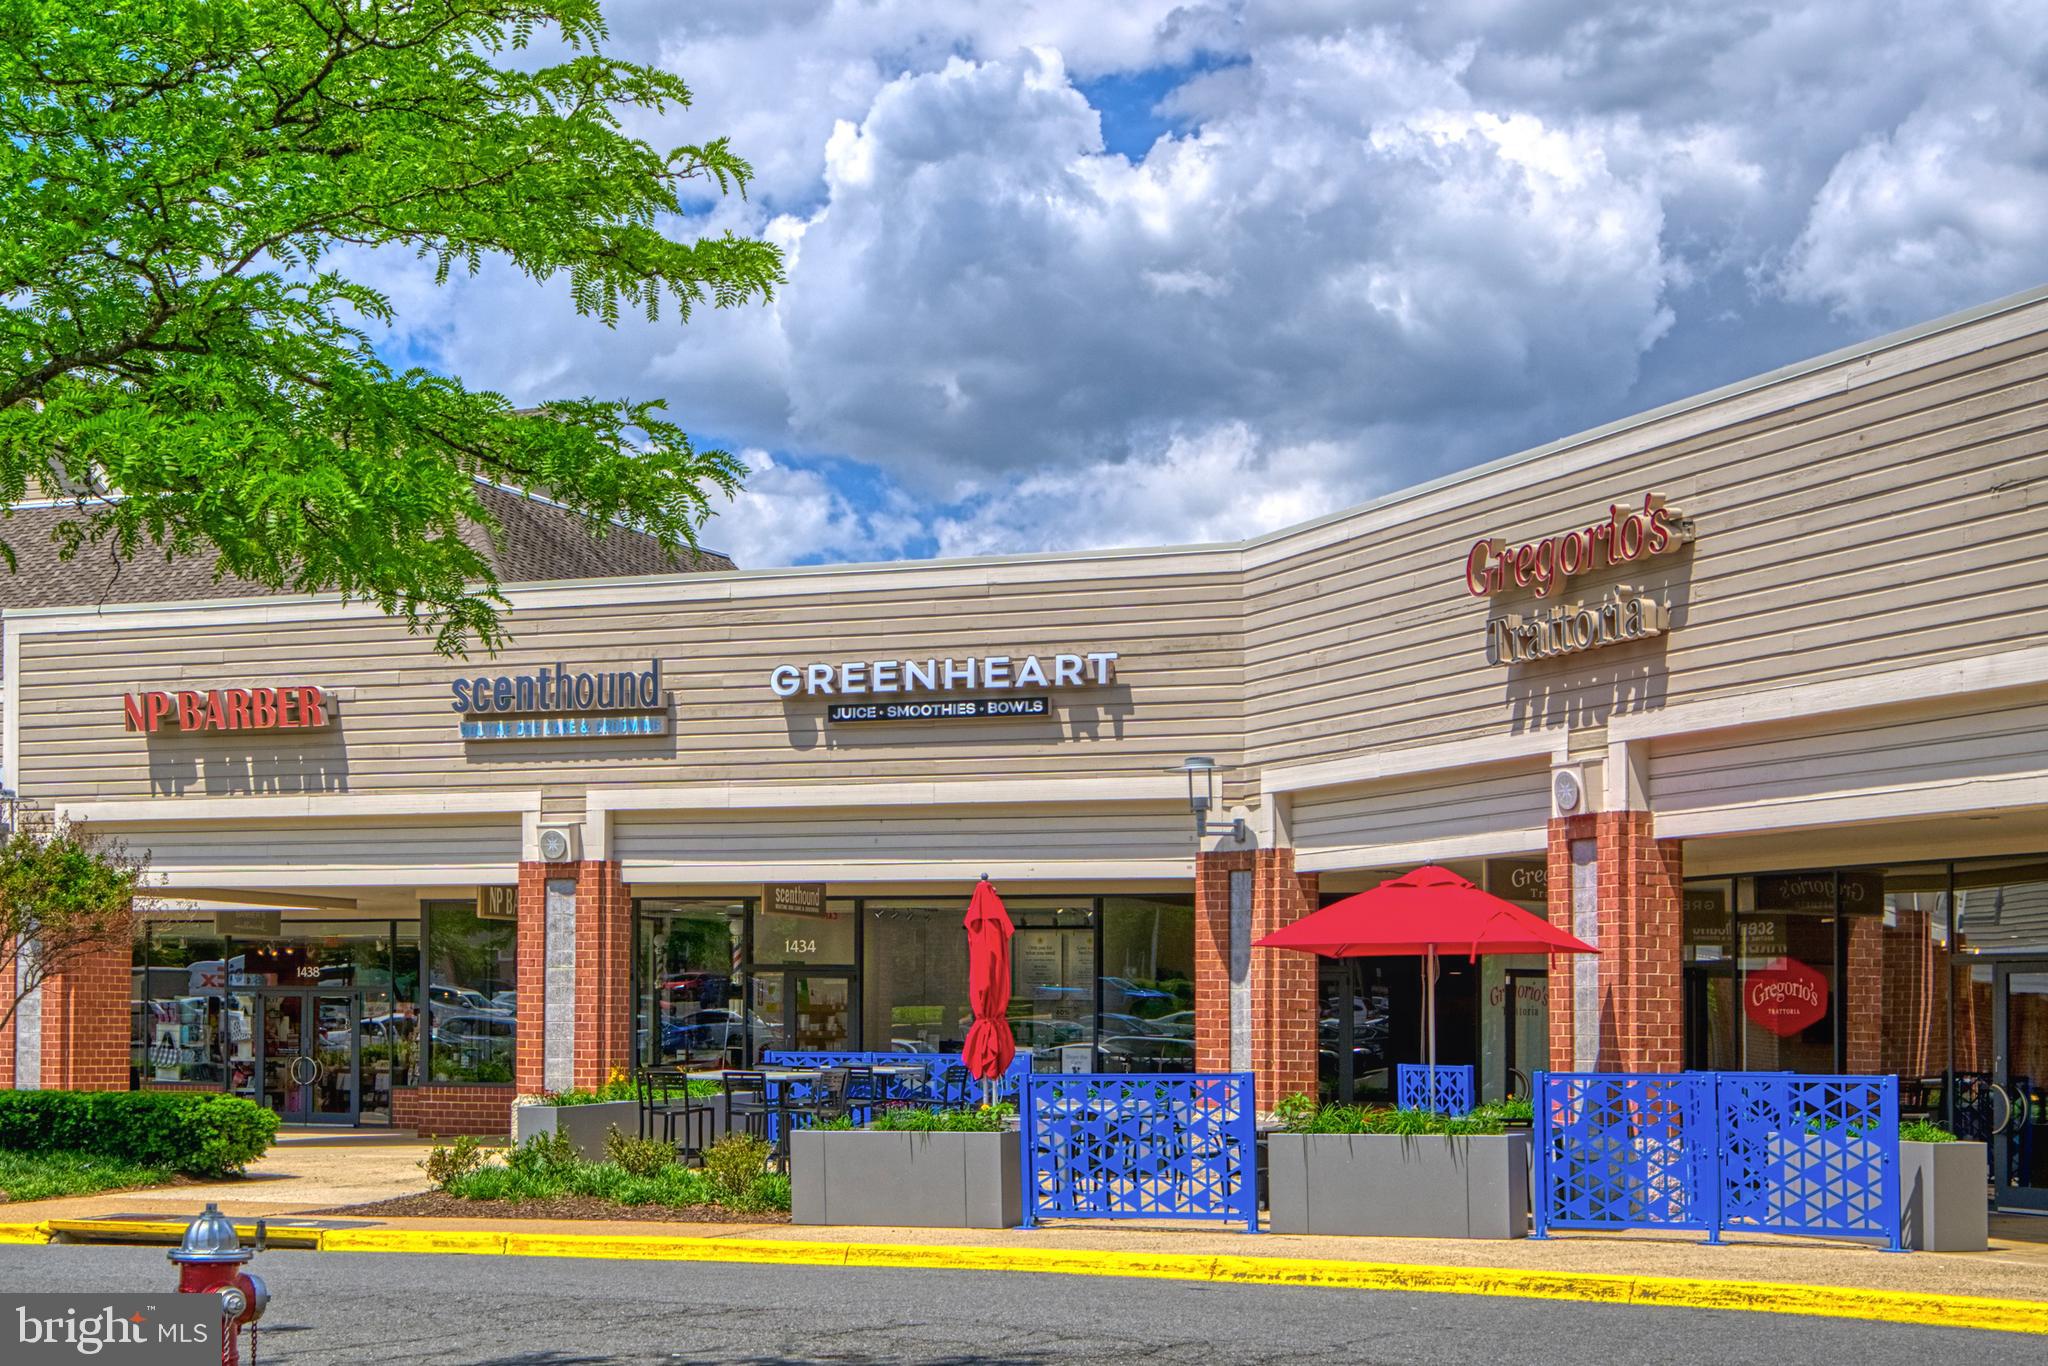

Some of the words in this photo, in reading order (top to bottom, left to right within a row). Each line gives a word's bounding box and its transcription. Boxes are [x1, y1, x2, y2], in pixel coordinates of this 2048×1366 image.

[1466, 493, 1671, 599] Gregorio's
[1486, 584, 1648, 666] Trattoria
[451, 658, 661, 713] scenthound
[769, 652, 1119, 697] GREENHEART
[124, 690, 171, 732] NP
[178, 686, 325, 732] BARBER
[832, 706, 878, 720] JUICE
[887, 702, 976, 719] SMOOTHIES
[987, 700, 1044, 715] BOWLS
[489, 886, 503, 913] NP
[775, 885, 820, 906] scenthound
[785, 939, 817, 953] 1434
[296, 966, 320, 978] 1438
[1752, 977, 1819, 1007] Gregorio's
